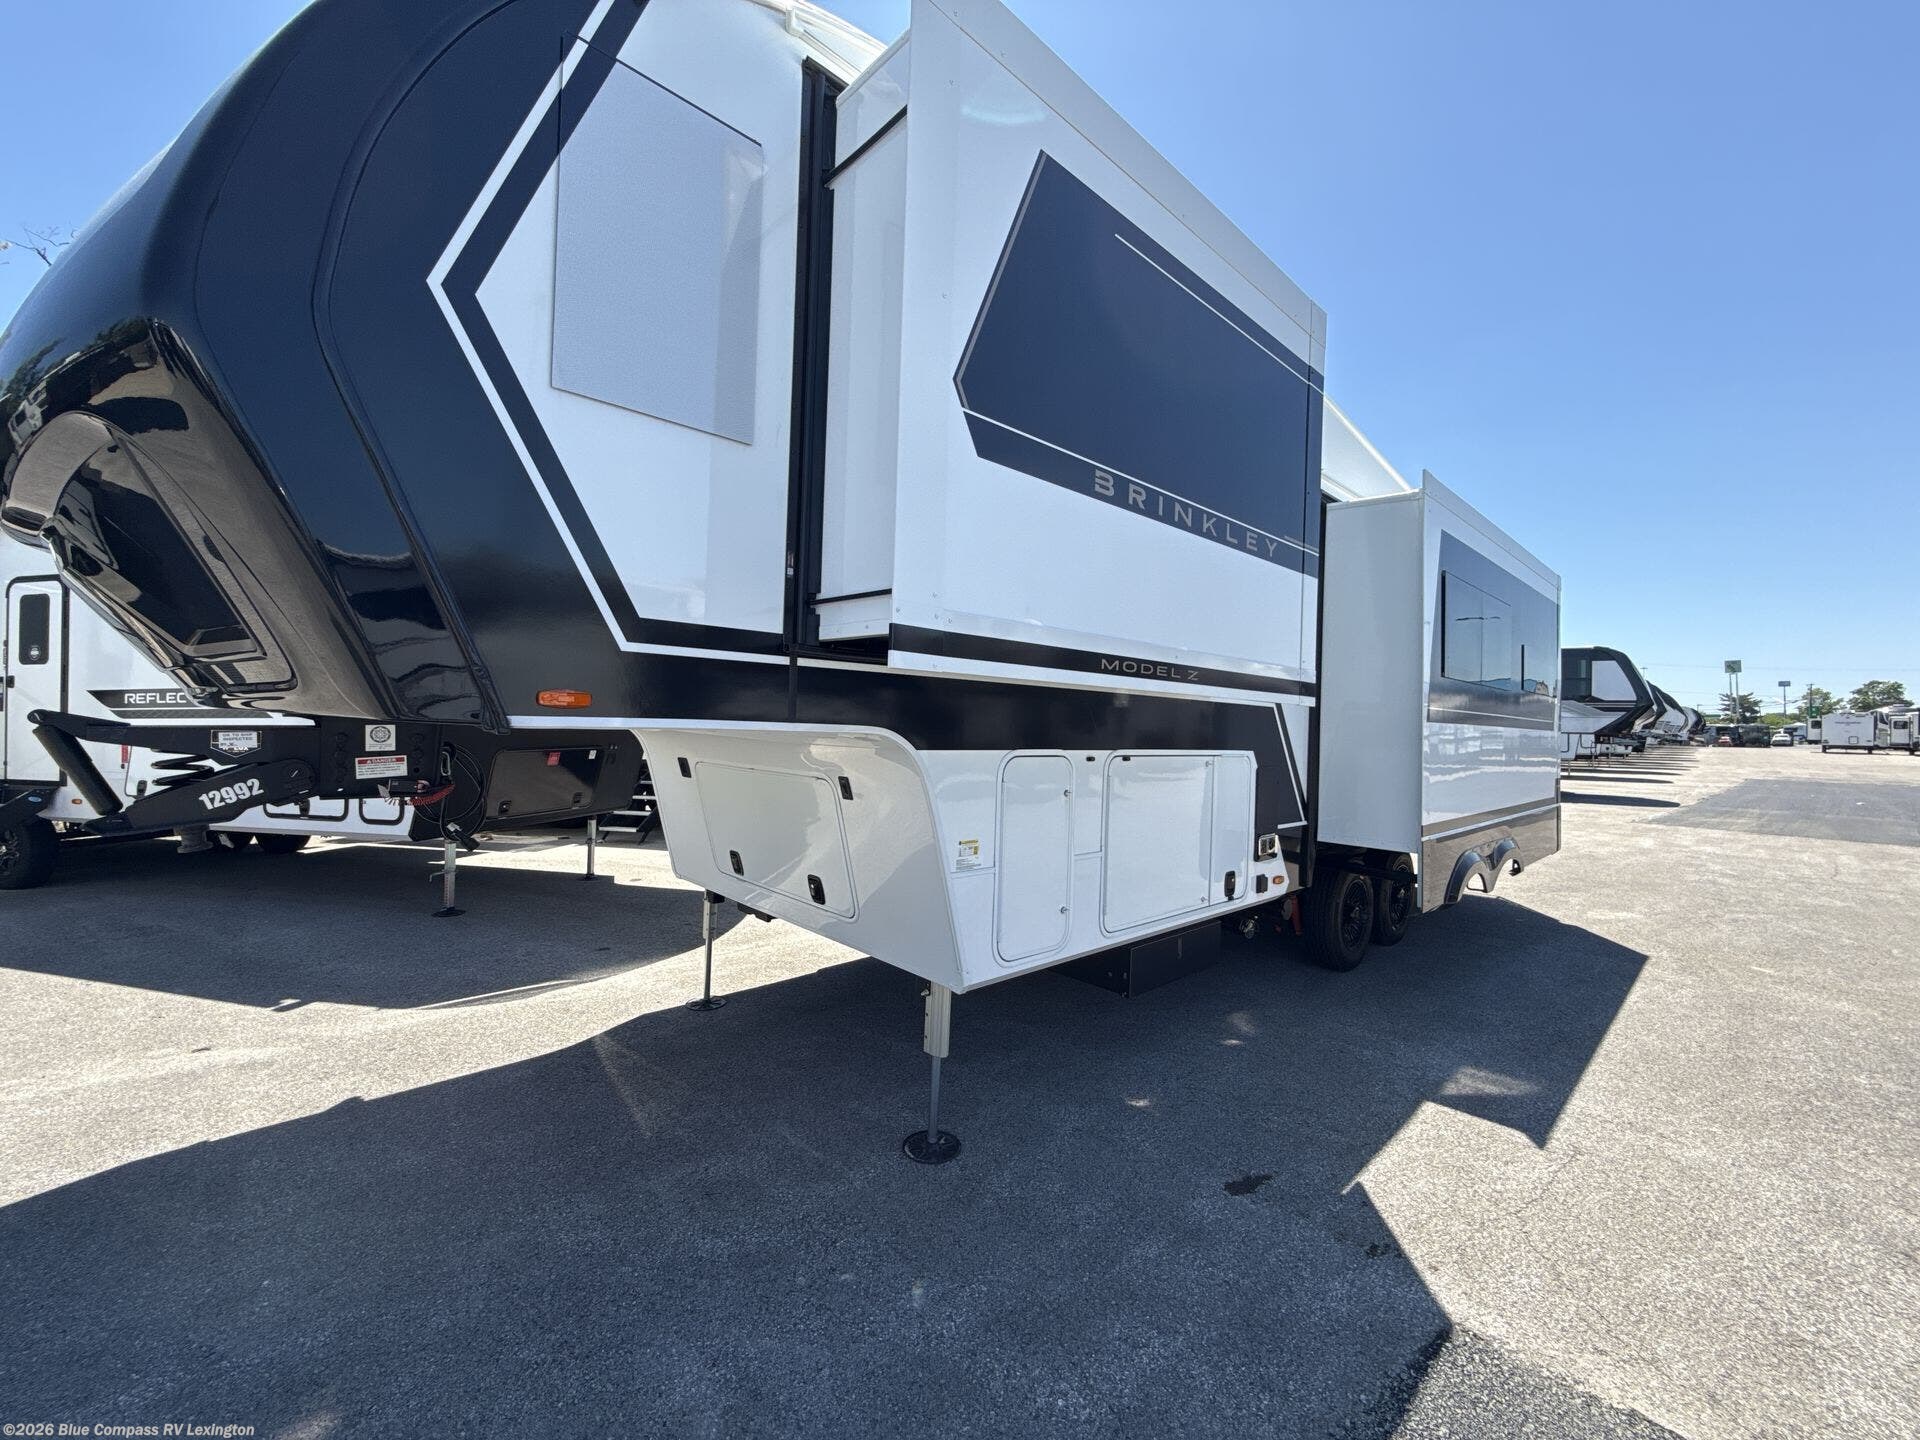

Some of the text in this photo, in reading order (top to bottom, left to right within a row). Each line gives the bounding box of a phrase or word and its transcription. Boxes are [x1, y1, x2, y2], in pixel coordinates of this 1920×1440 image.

[1094, 468, 1278, 557] BRINKLEY
[1101, 658, 1200, 681] MODEL Z
[198, 778, 265, 810] 12992
